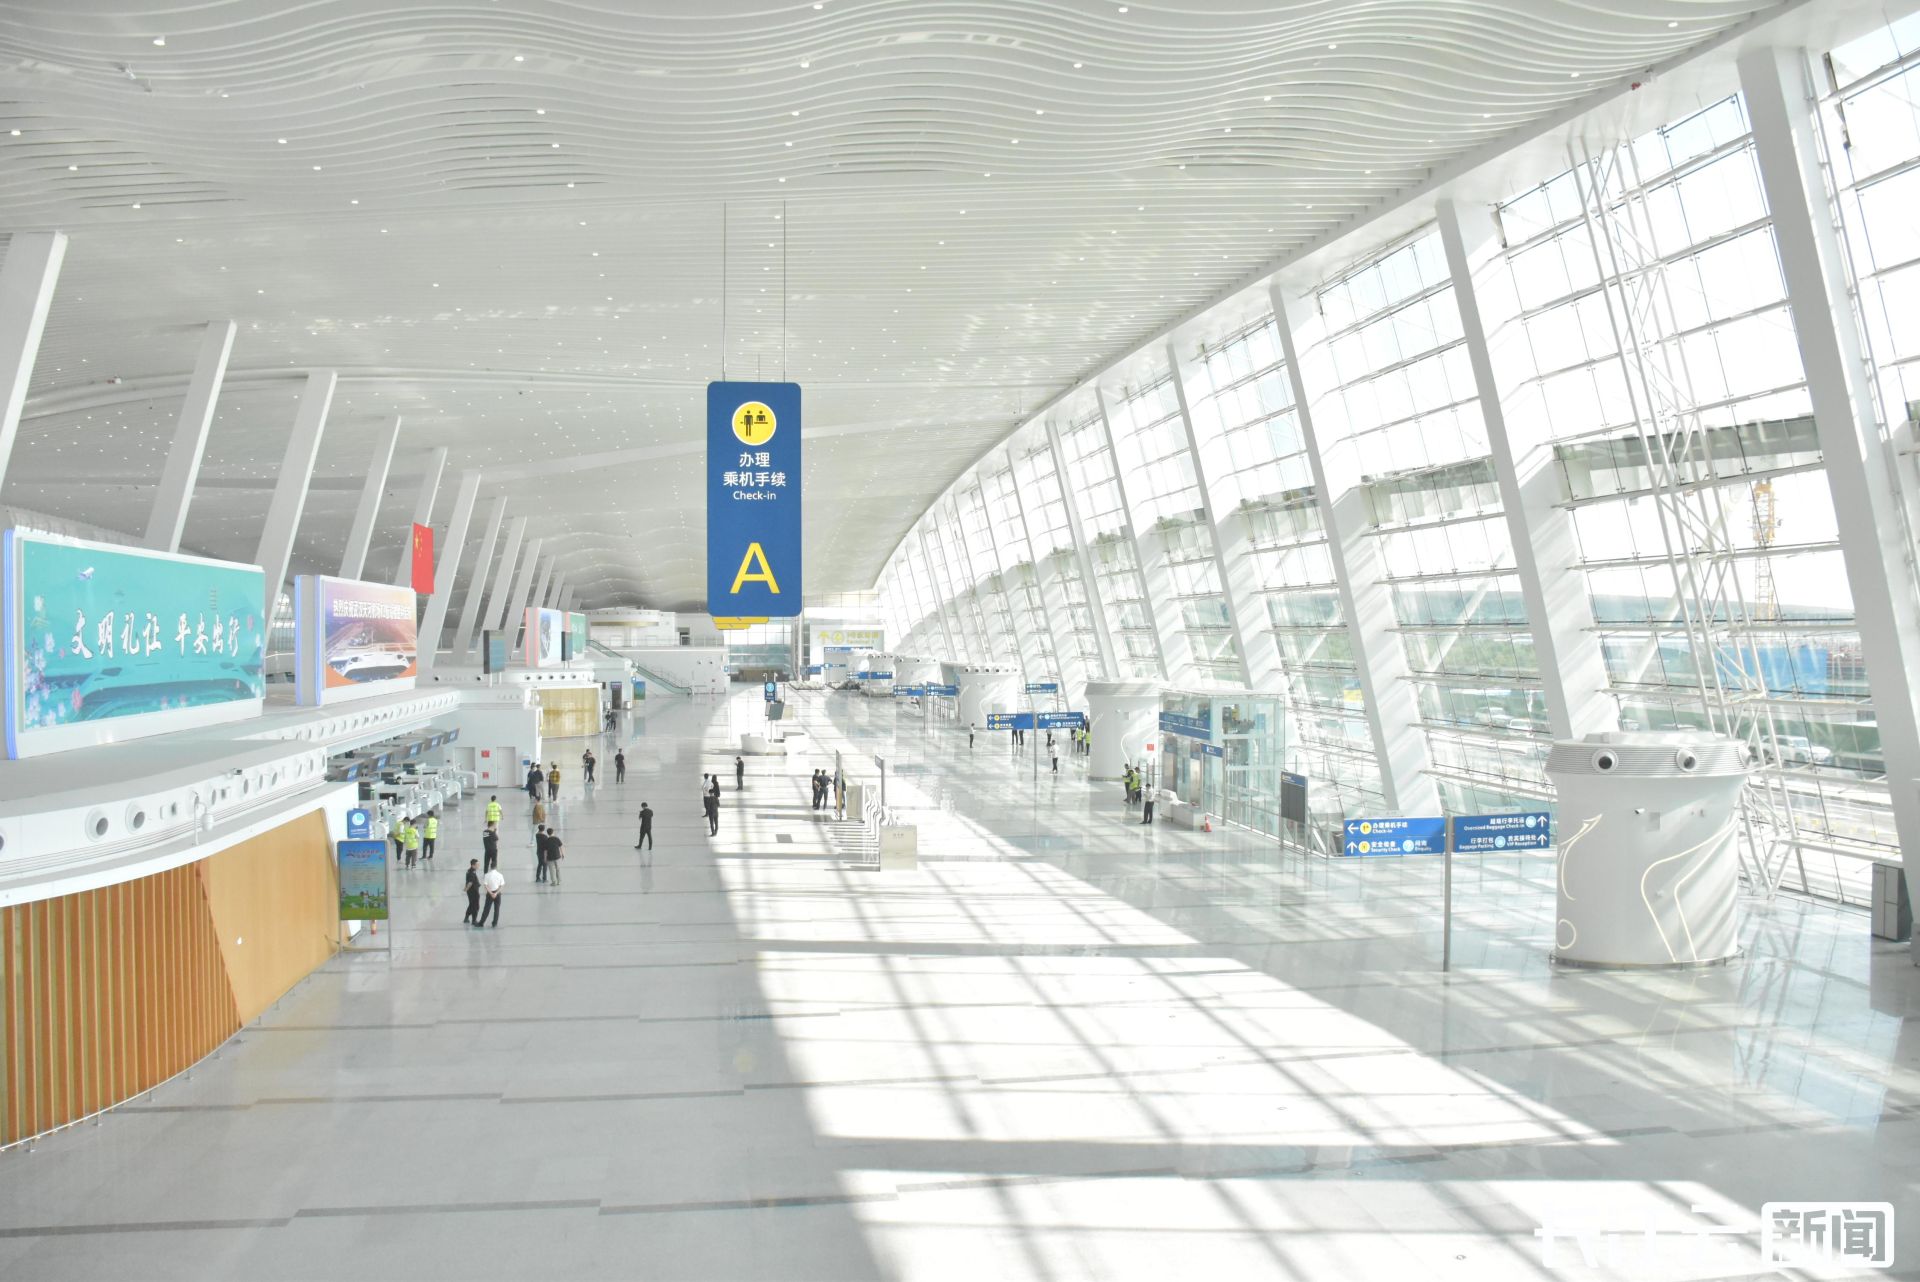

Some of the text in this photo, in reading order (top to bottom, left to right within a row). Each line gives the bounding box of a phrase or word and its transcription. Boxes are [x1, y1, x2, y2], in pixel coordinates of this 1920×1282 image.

[739, 452, 770, 468] 办理
[723, 472, 786, 488] 乘机手续
[733, 491, 777, 500] Check-in
[729, 542, 781, 594] A
[72, 609, 240, 659] 文明礼让 平安出行
[1372, 821, 1409, 829] 办理乘机手续
